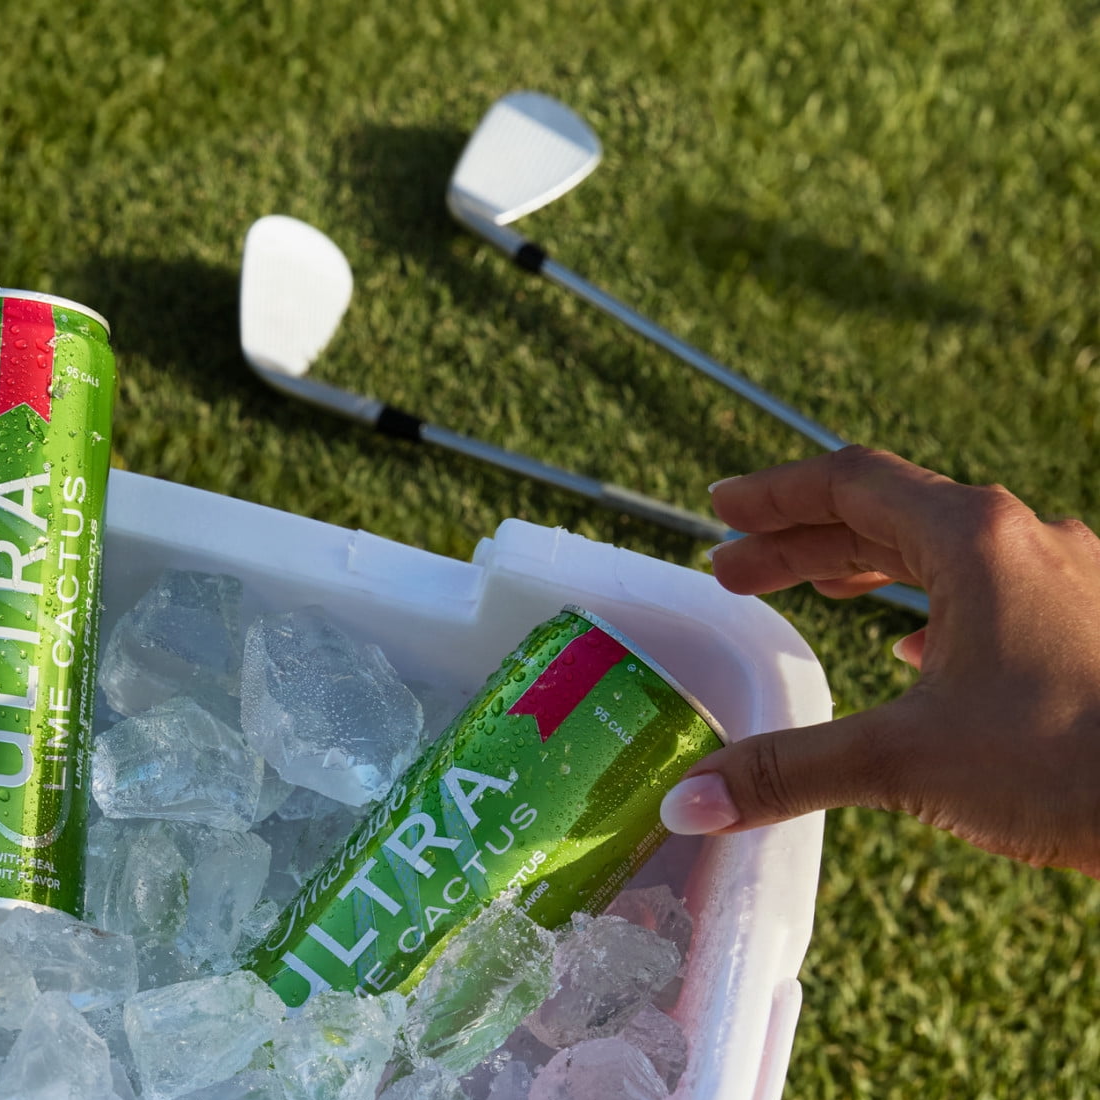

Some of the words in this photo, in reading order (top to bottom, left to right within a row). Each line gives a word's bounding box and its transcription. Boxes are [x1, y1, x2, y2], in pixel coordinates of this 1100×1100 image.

[66, 365, 79, 380] 95
[81, 373, 100, 388] CALS
[52, 475, 87, 668] CACTUS
[88, 519, 98, 594] CACTUS
[84, 597, 93, 646] PEAR
[79, 648, 90, 726] PRICKLY
[43, 687, 72, 791] LIME
[594, 706, 610, 722] 95
[608, 720, 634, 745] CALS
[75, 748, 84, 790] LIME
[18, 871, 61, 890] FLAVOR
[29, 857, 58, 873] REAL
[398, 802, 538, 953] CACTUS
[507, 850, 547, 890] CTUS
